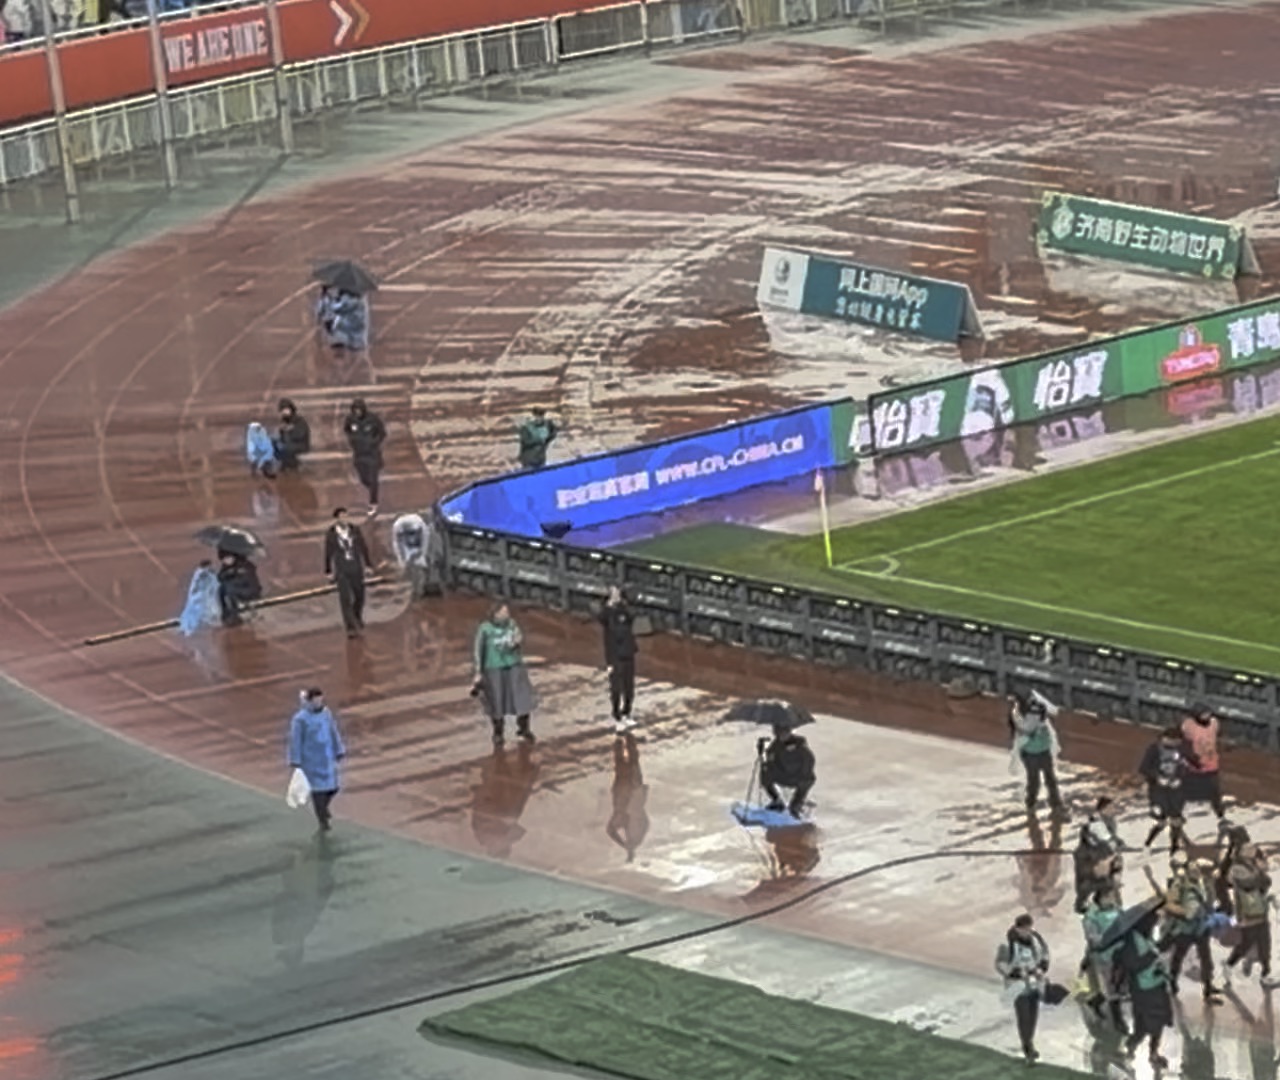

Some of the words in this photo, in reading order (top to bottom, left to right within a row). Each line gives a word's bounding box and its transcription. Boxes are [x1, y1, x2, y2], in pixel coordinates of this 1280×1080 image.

[163, 33, 196, 73] WE
[197, 26, 232, 67] ARE
[231, 19, 268, 58] ONE
[1075, 212, 1226, 263] 济南野生动物世界
